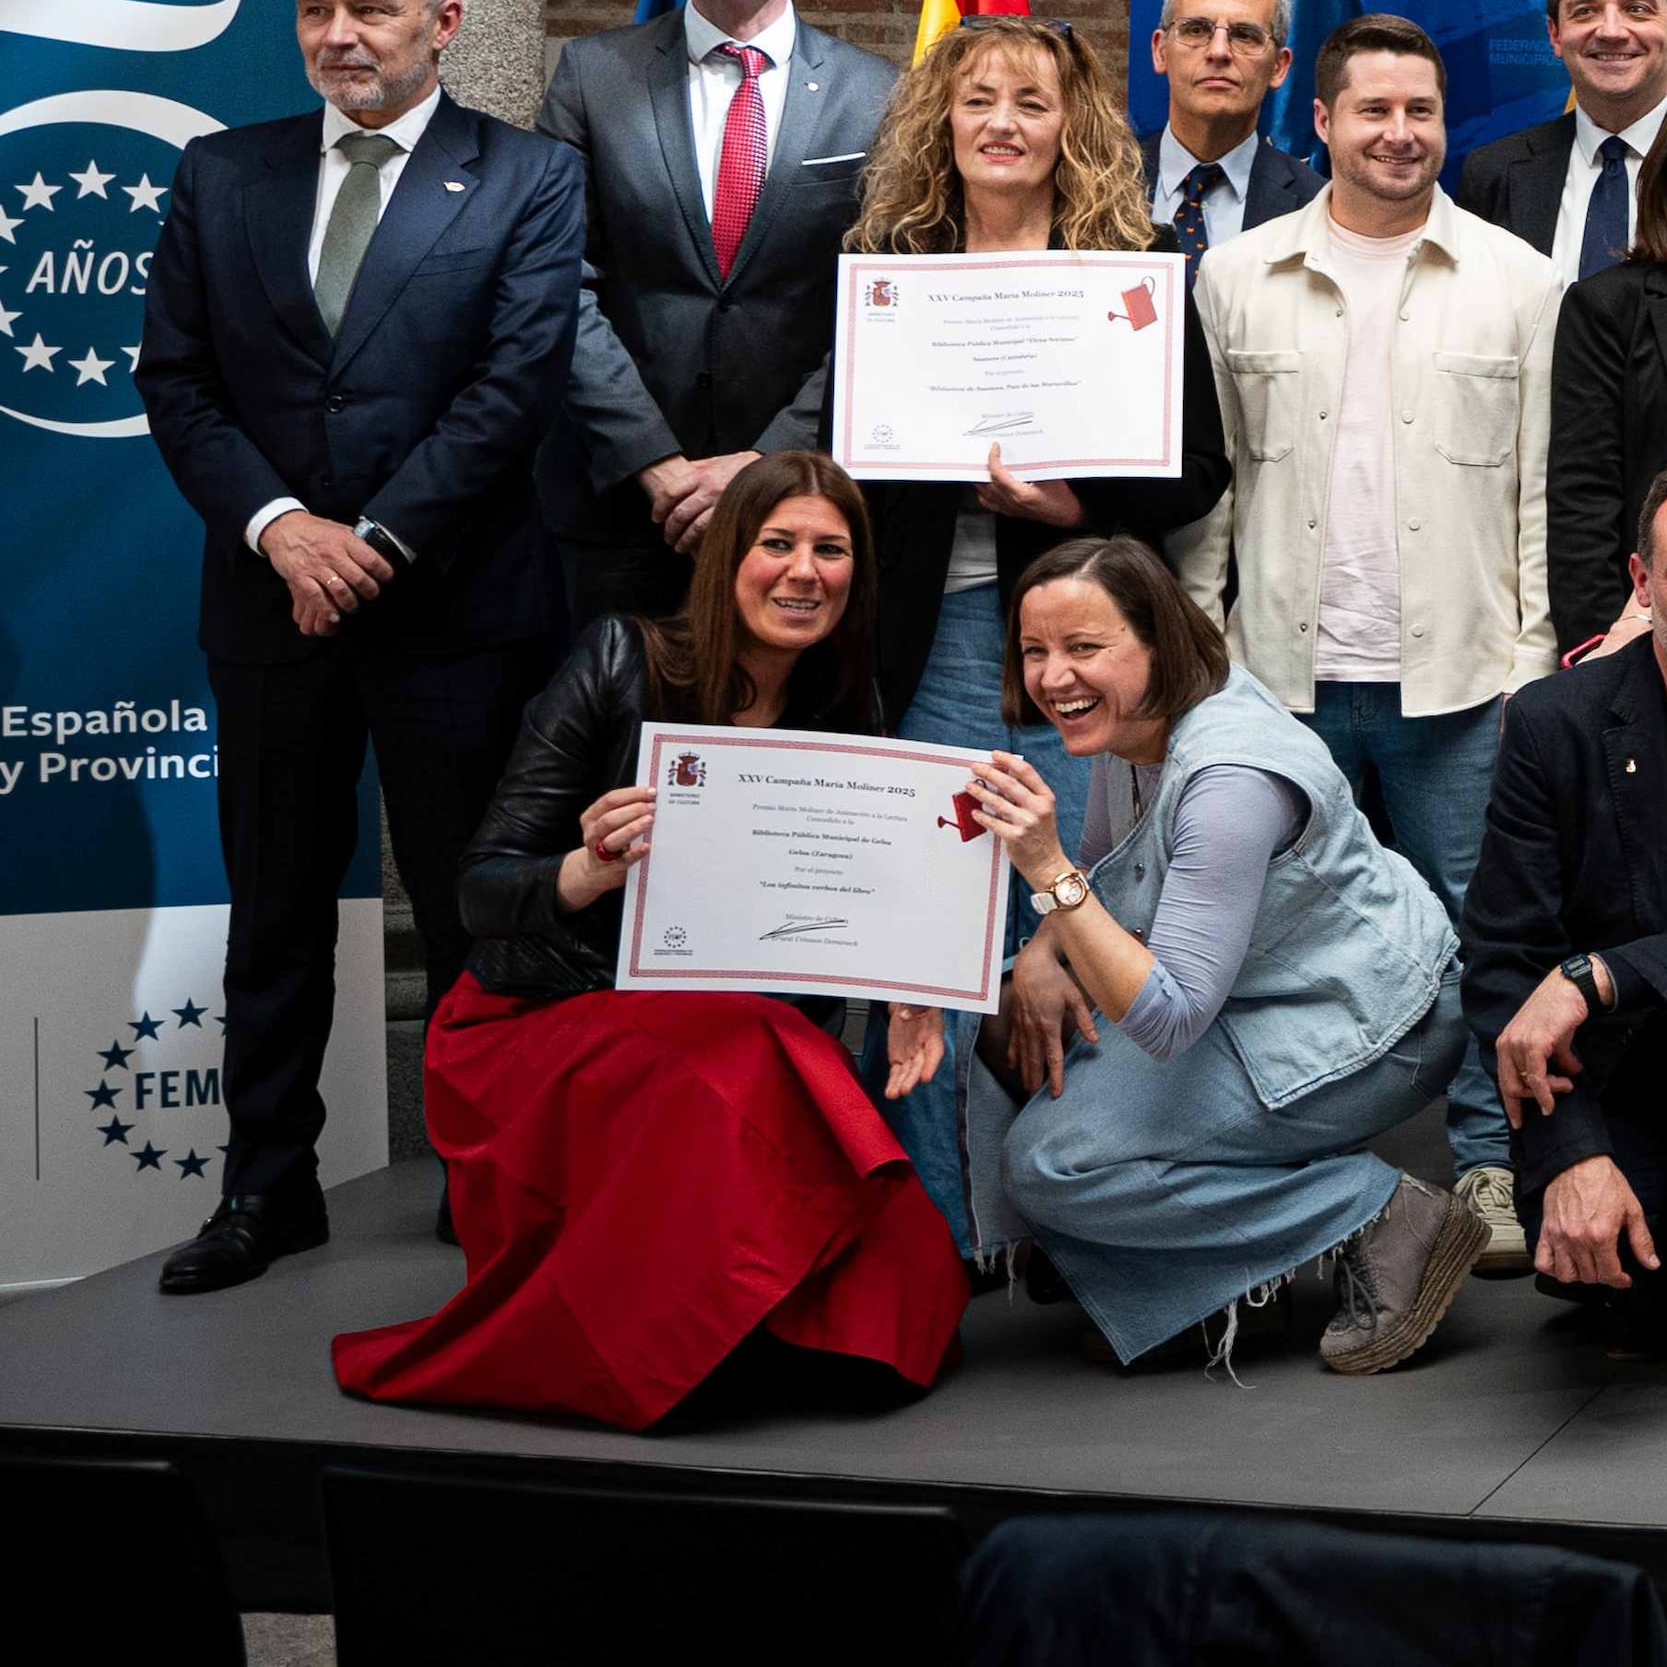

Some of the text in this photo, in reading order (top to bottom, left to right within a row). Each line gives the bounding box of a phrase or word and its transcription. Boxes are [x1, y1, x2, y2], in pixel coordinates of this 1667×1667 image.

[25, 239, 154, 295] AÑOS
[952, 293, 991, 301] Campaña
[1057, 290, 1084, 298] 2025
[2, 700, 208, 745] Española
[0, 745, 218, 795] y Provinci
[738, 773, 916, 797] XXV Campaña María Moliner 2025
[791, 831, 820, 839] Pública
[822, 833, 859, 843] Municipal
[136, 1068, 220, 1110] FEM
